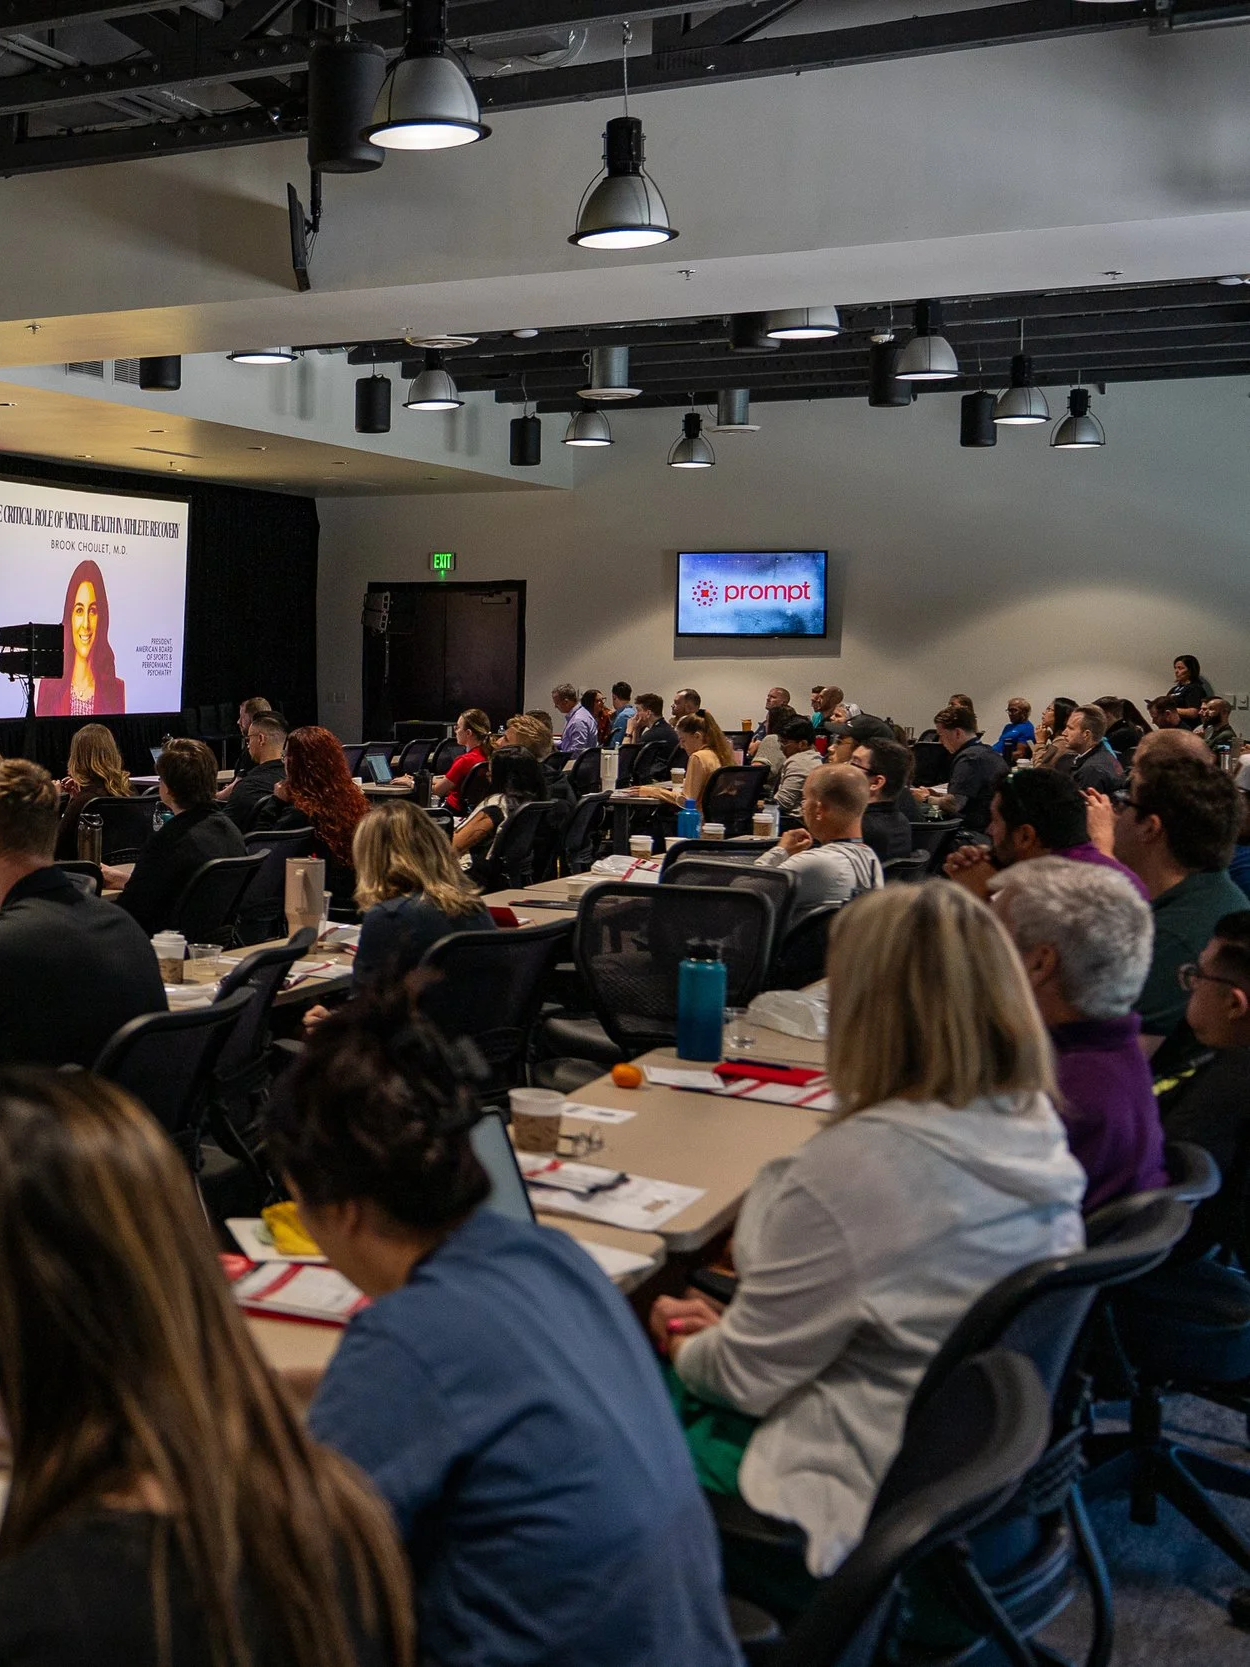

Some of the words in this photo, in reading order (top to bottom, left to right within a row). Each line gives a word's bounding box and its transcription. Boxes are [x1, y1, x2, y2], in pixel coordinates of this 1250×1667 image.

[3, 505, 34, 526] CRITICAL
[35, 508, 53, 527] ROLE
[54, 510, 64, 528] OF
[64, 511, 90, 531] MENTAL
[91, 514, 115, 533] HEALTH
[123, 518, 149, 536] ATHLETE
[50, 539, 76, 551] BROOK
[77, 541, 111, 555] CHOULET,
[112, 545, 128, 555] M.D.
[433, 553, 452, 569] EXIT
[724, 581, 811, 603] prompt
